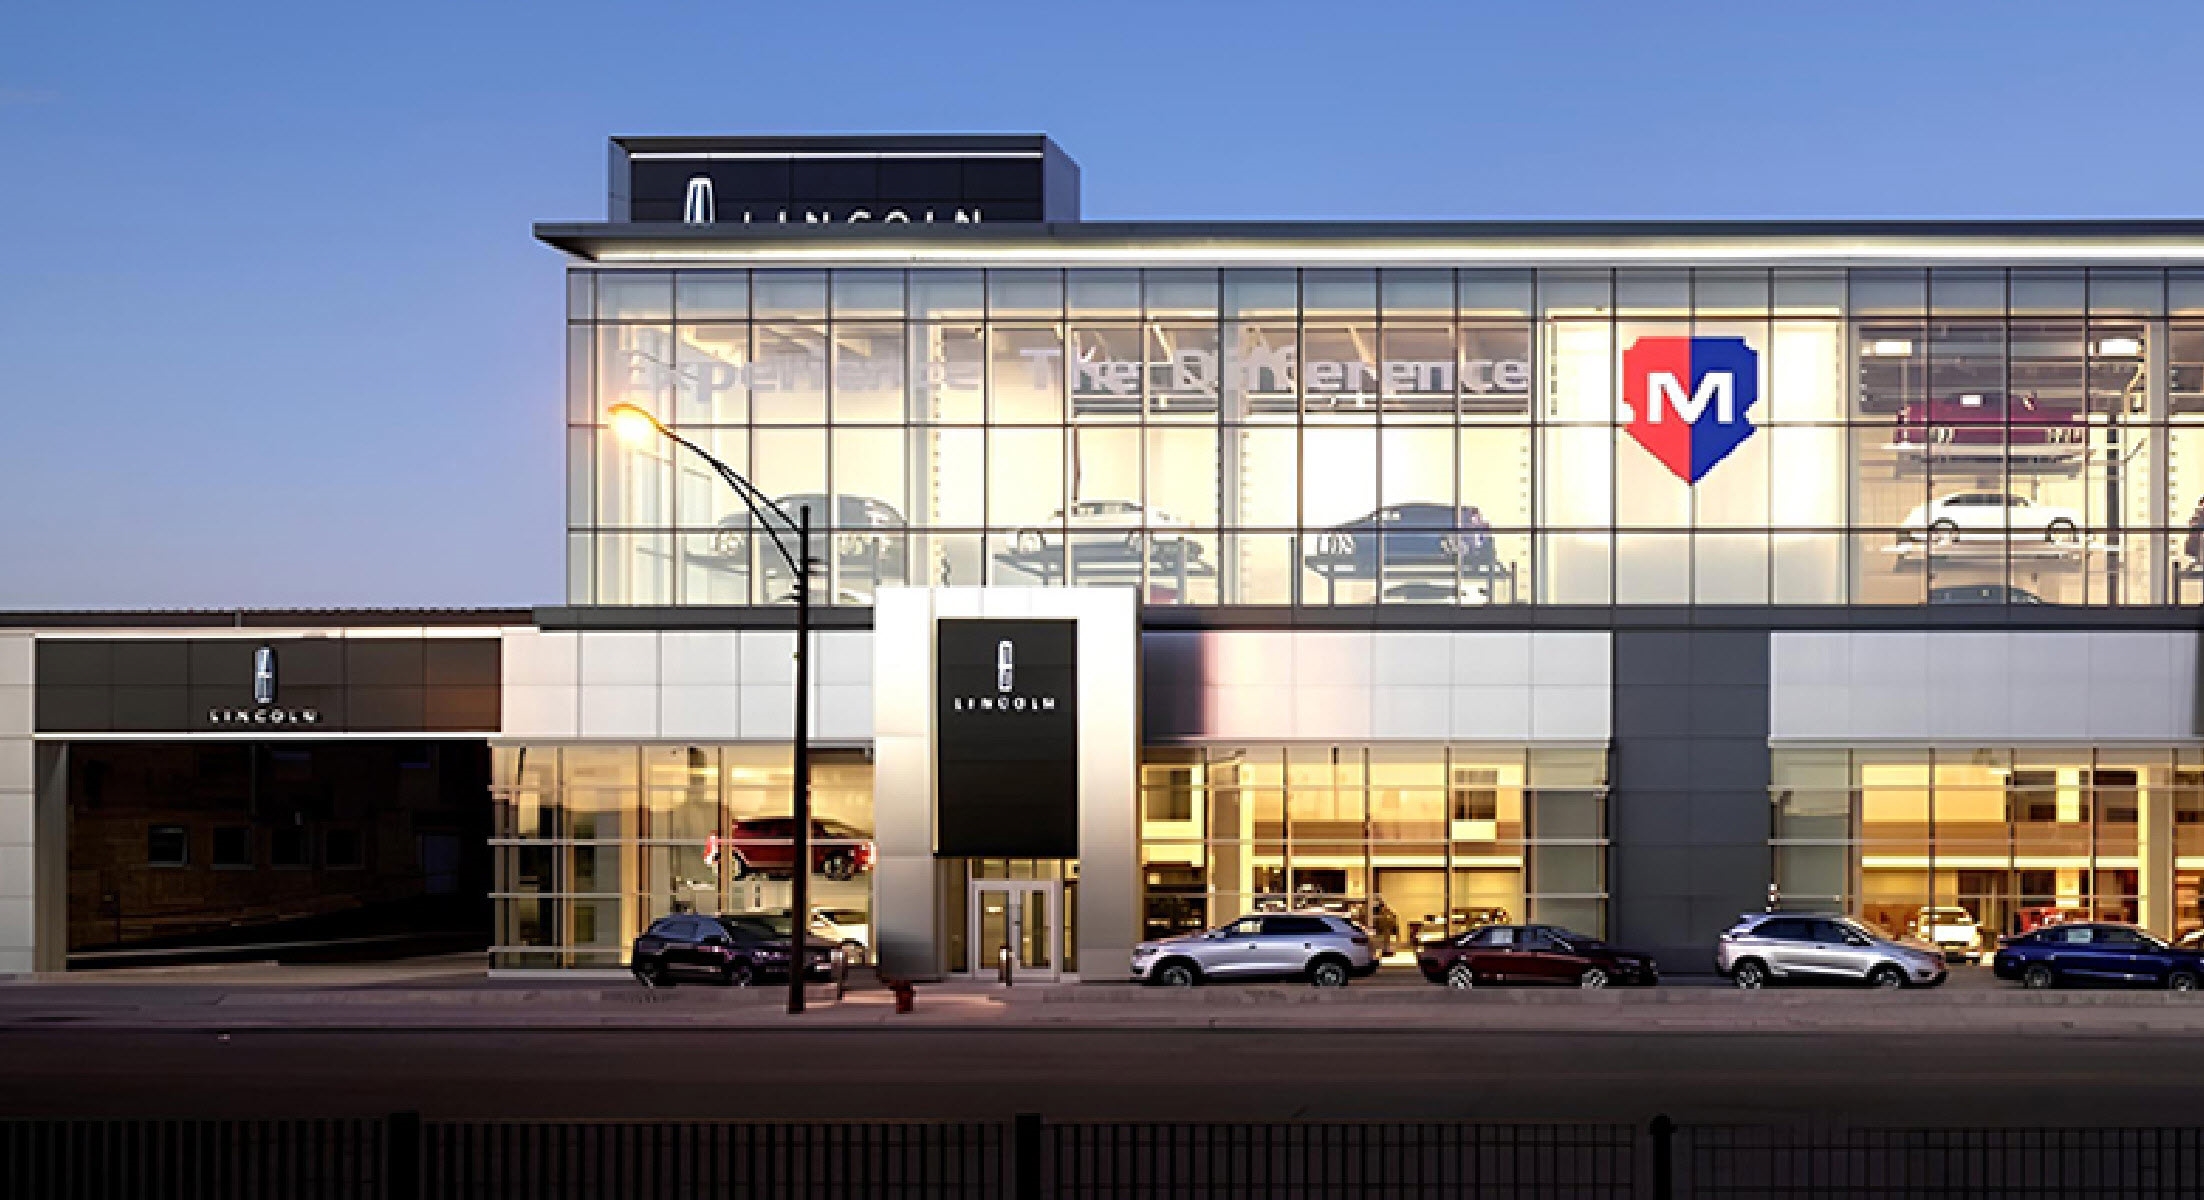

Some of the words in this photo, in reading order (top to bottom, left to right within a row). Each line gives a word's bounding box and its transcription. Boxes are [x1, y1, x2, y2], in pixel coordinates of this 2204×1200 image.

[1019, 345, 1142, 392] The
[1647, 371, 1734, 423] M
[209, 708, 316, 723] LINCOLN
[954, 696, 1054, 711] LINCOLN
